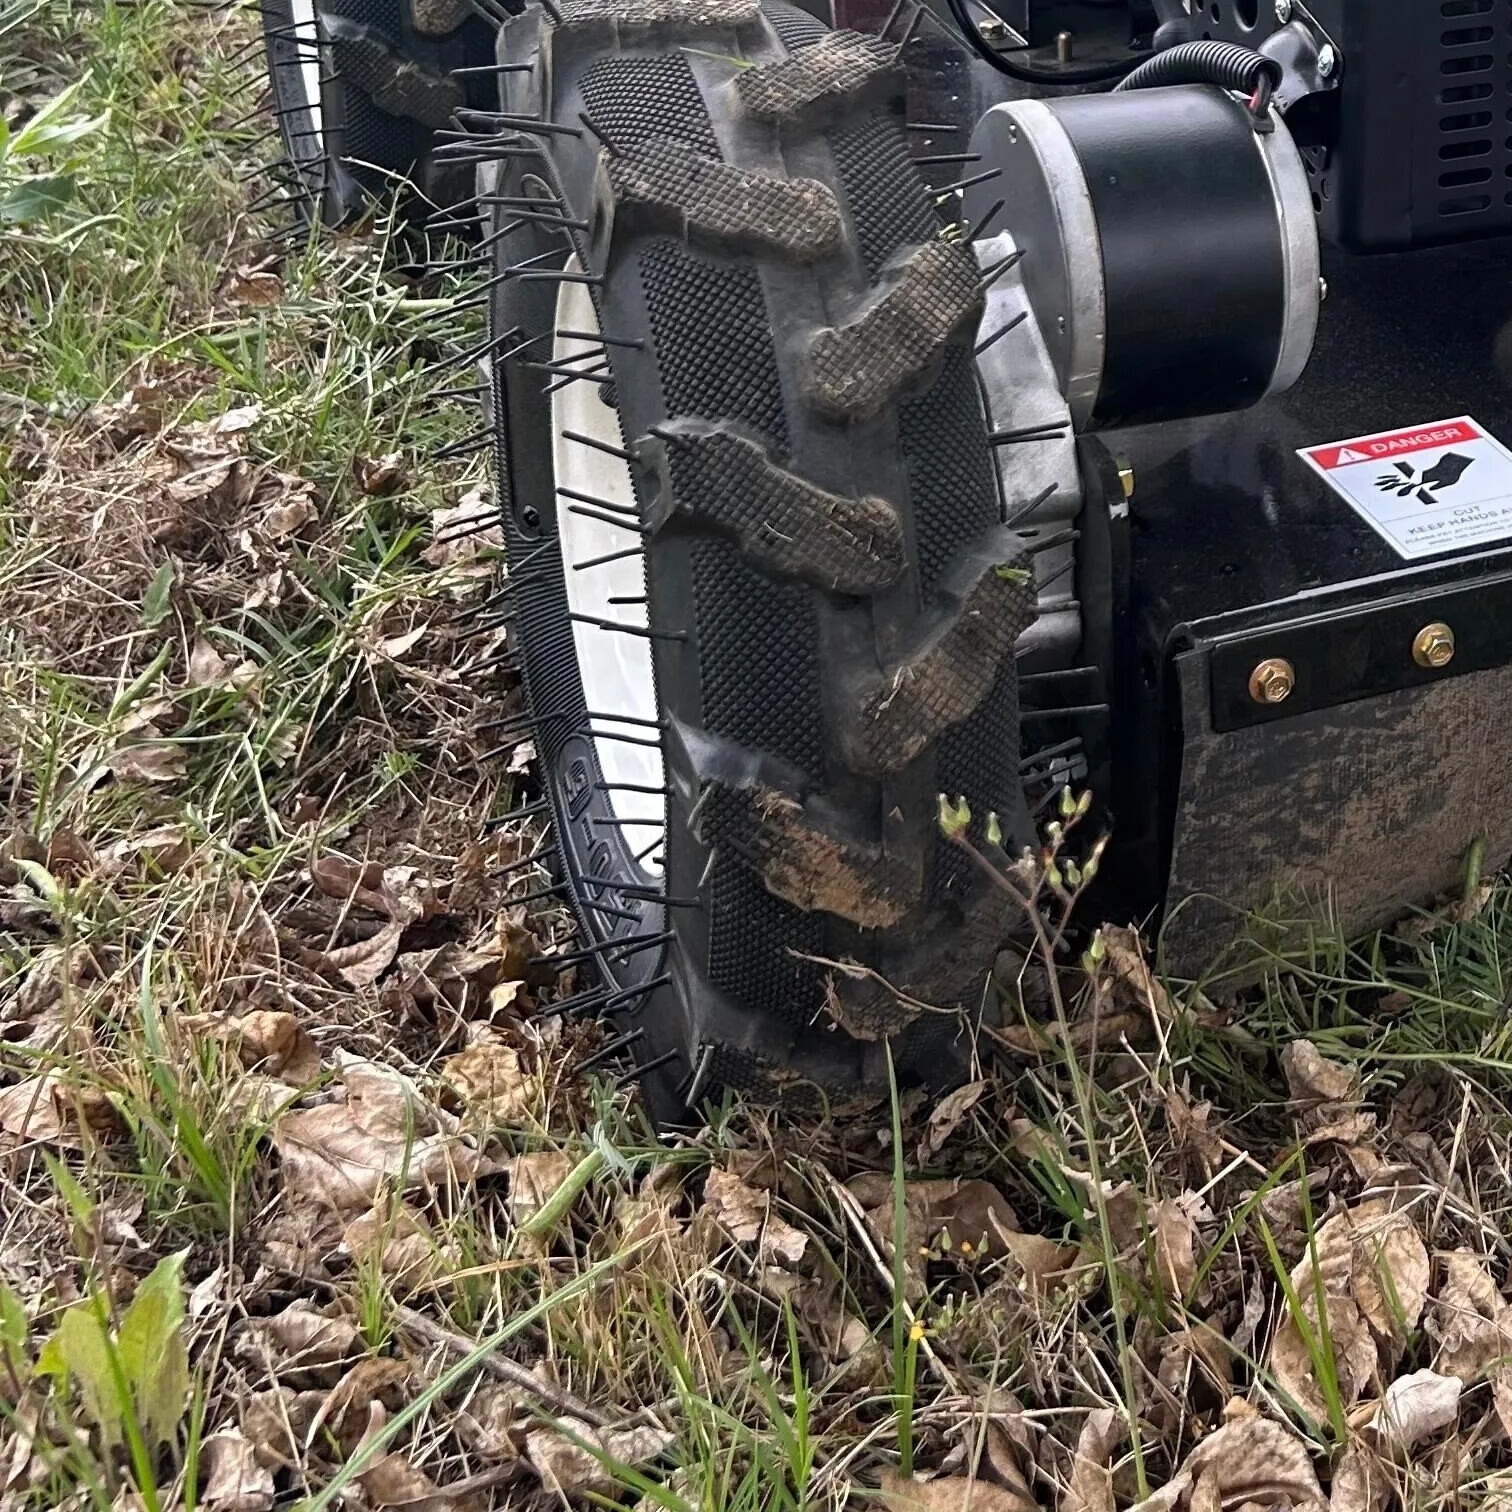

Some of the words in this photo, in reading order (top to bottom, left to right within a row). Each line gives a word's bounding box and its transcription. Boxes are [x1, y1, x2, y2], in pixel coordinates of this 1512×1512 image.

[1369, 427, 1462, 454] DANGER
[1408, 521, 1446, 534] KEEP
[1448, 510, 1499, 526] HANDS
[1453, 505, 1481, 516] CUT
